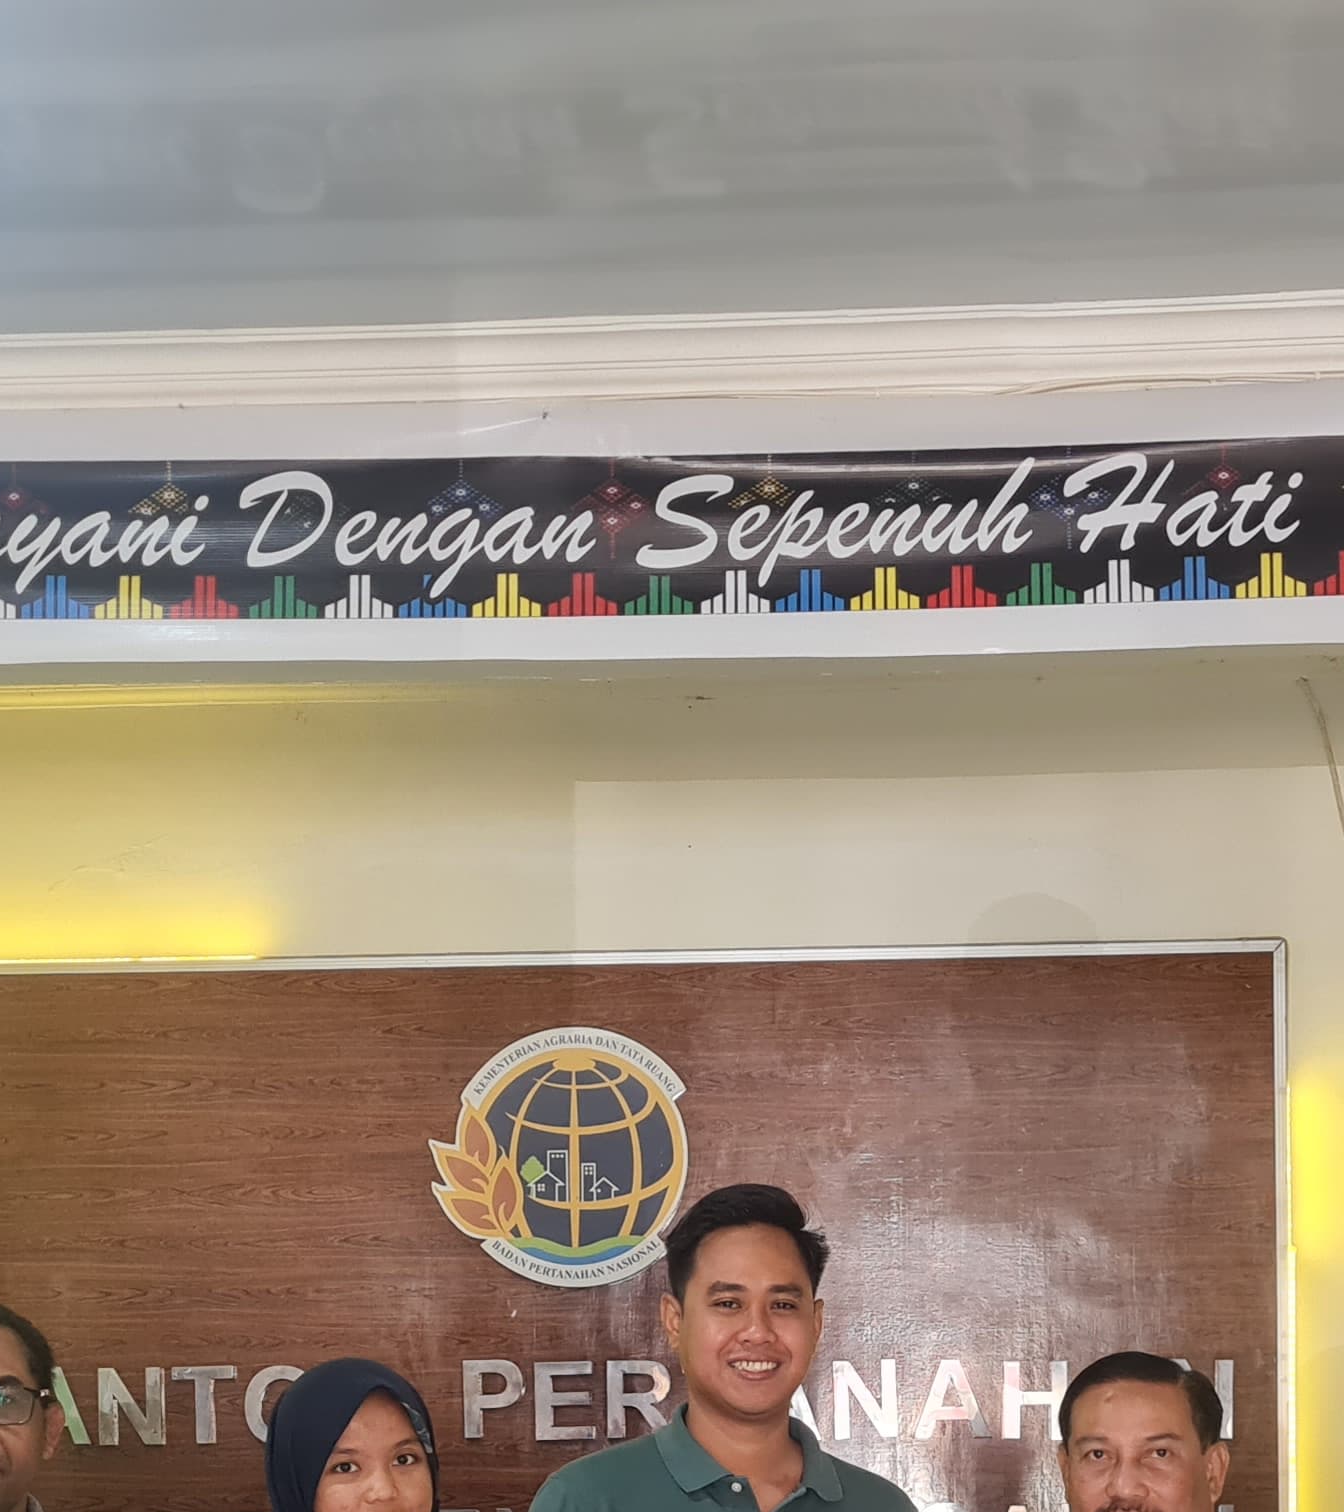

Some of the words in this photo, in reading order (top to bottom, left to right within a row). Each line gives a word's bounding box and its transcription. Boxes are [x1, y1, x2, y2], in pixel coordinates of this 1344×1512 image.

[239, 471, 597, 589] Dengan
[635, 458, 1036, 586] Sepenuh
[1076, 454, 1305, 555] Hati
[473, 1038, 541, 1096] KEMENTERIAN
[543, 1034, 593, 1049] AGRARIA
[596, 1036, 619, 1050] DAN
[620, 1043, 645, 1065] TATA
[644, 1060, 676, 1093] RUANG
[492, 1240, 528, 1269] BADAN
[529, 1262, 606, 1280] PERTANAHAN
[606, 1239, 661, 1273] NASIONAL
[53, 1364, 304, 1445] ANTO
